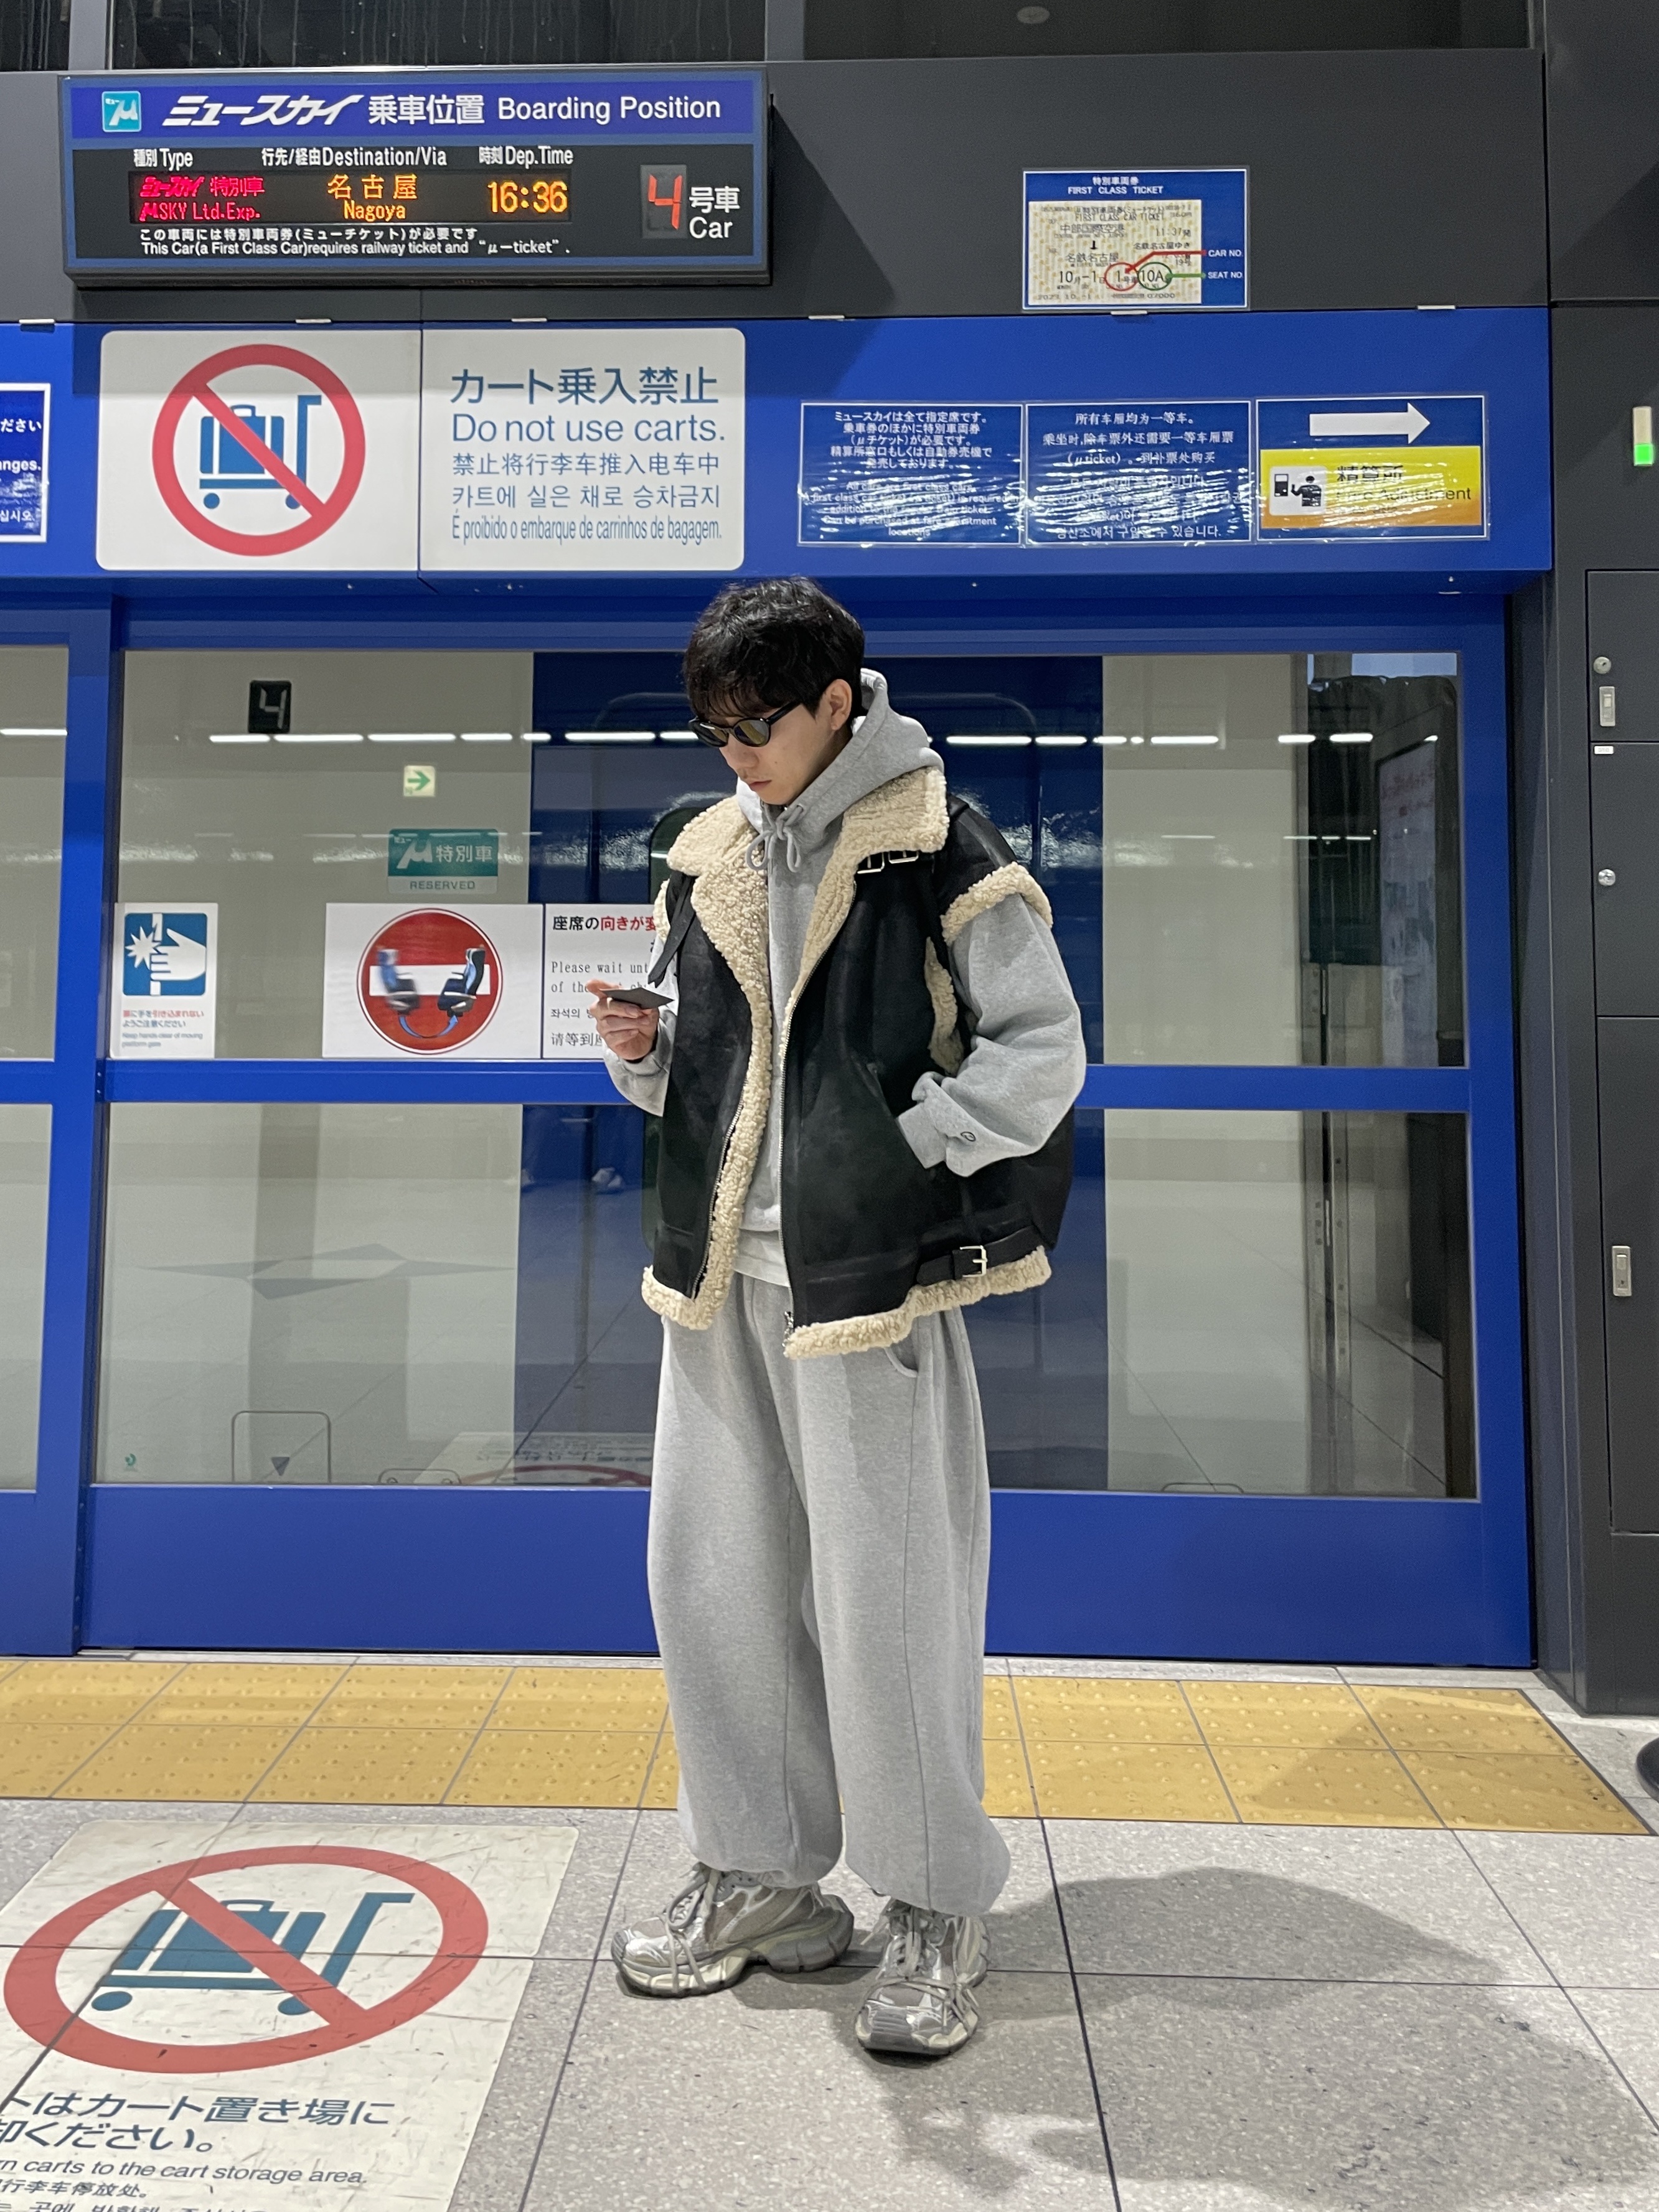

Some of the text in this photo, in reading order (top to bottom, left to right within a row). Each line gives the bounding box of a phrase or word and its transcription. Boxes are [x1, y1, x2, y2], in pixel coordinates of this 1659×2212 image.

[162, 93, 721, 126] ミュースカイ 乗車位置 Boarding Position
[133, 148, 193, 171] 種別 Type
[505, 146, 574, 169] Dep.Time
[210, 177, 265, 197] 特別車
[327, 174, 418, 199] 名古屋
[487, 180, 568, 213] 16:36
[1098, 186, 1127, 194] CLASS
[344, 200, 407, 222] Nagoya
[648, 175, 682, 230] 4
[689, 187, 740, 213] 号車
[689, 217, 733, 238] Car
[141, 241, 169, 255] This
[212, 241, 239, 254] First
[242, 241, 278, 255] Class
[361, 240, 405, 256] railway
[408, 240, 442, 254] ticket
[444, 241, 469, 254] and
[450, 367, 718, 405] カート乗入禁止
[453, 413, 725, 442] Do not use carts.
[453, 452, 719, 476] 禁止将行李车推入电车中
[453, 485, 719, 508] 카트에 실은 채로 승차금지
[463, 515, 507, 545] proibido
[510, 523, 517, 539] o
[521, 515, 576, 545] embarque
[580, 515, 593, 539] de
[596, 515, 647, 539] carrinhos
[651, 515, 664, 539] de
[668, 515, 722, 546] bagagem.
[258, 688, 288, 730] 4
[436, 845, 492, 863] 特別車
[410, 881, 475, 890] RESERVED
[551, 961, 591, 973] Please
[598, 961, 623, 973] wait
[552, 982, 563, 993] of
[550, 1008, 580, 1019] 좌석의
[24, 2160, 85, 2174] carts
[91, 2161, 115, 2175] to
[119, 2161, 156, 2177] the
[160, 2164, 209, 2178] cart
[212, 2165, 303, 2185] storage
[309, 2168, 367, 2185] area.
